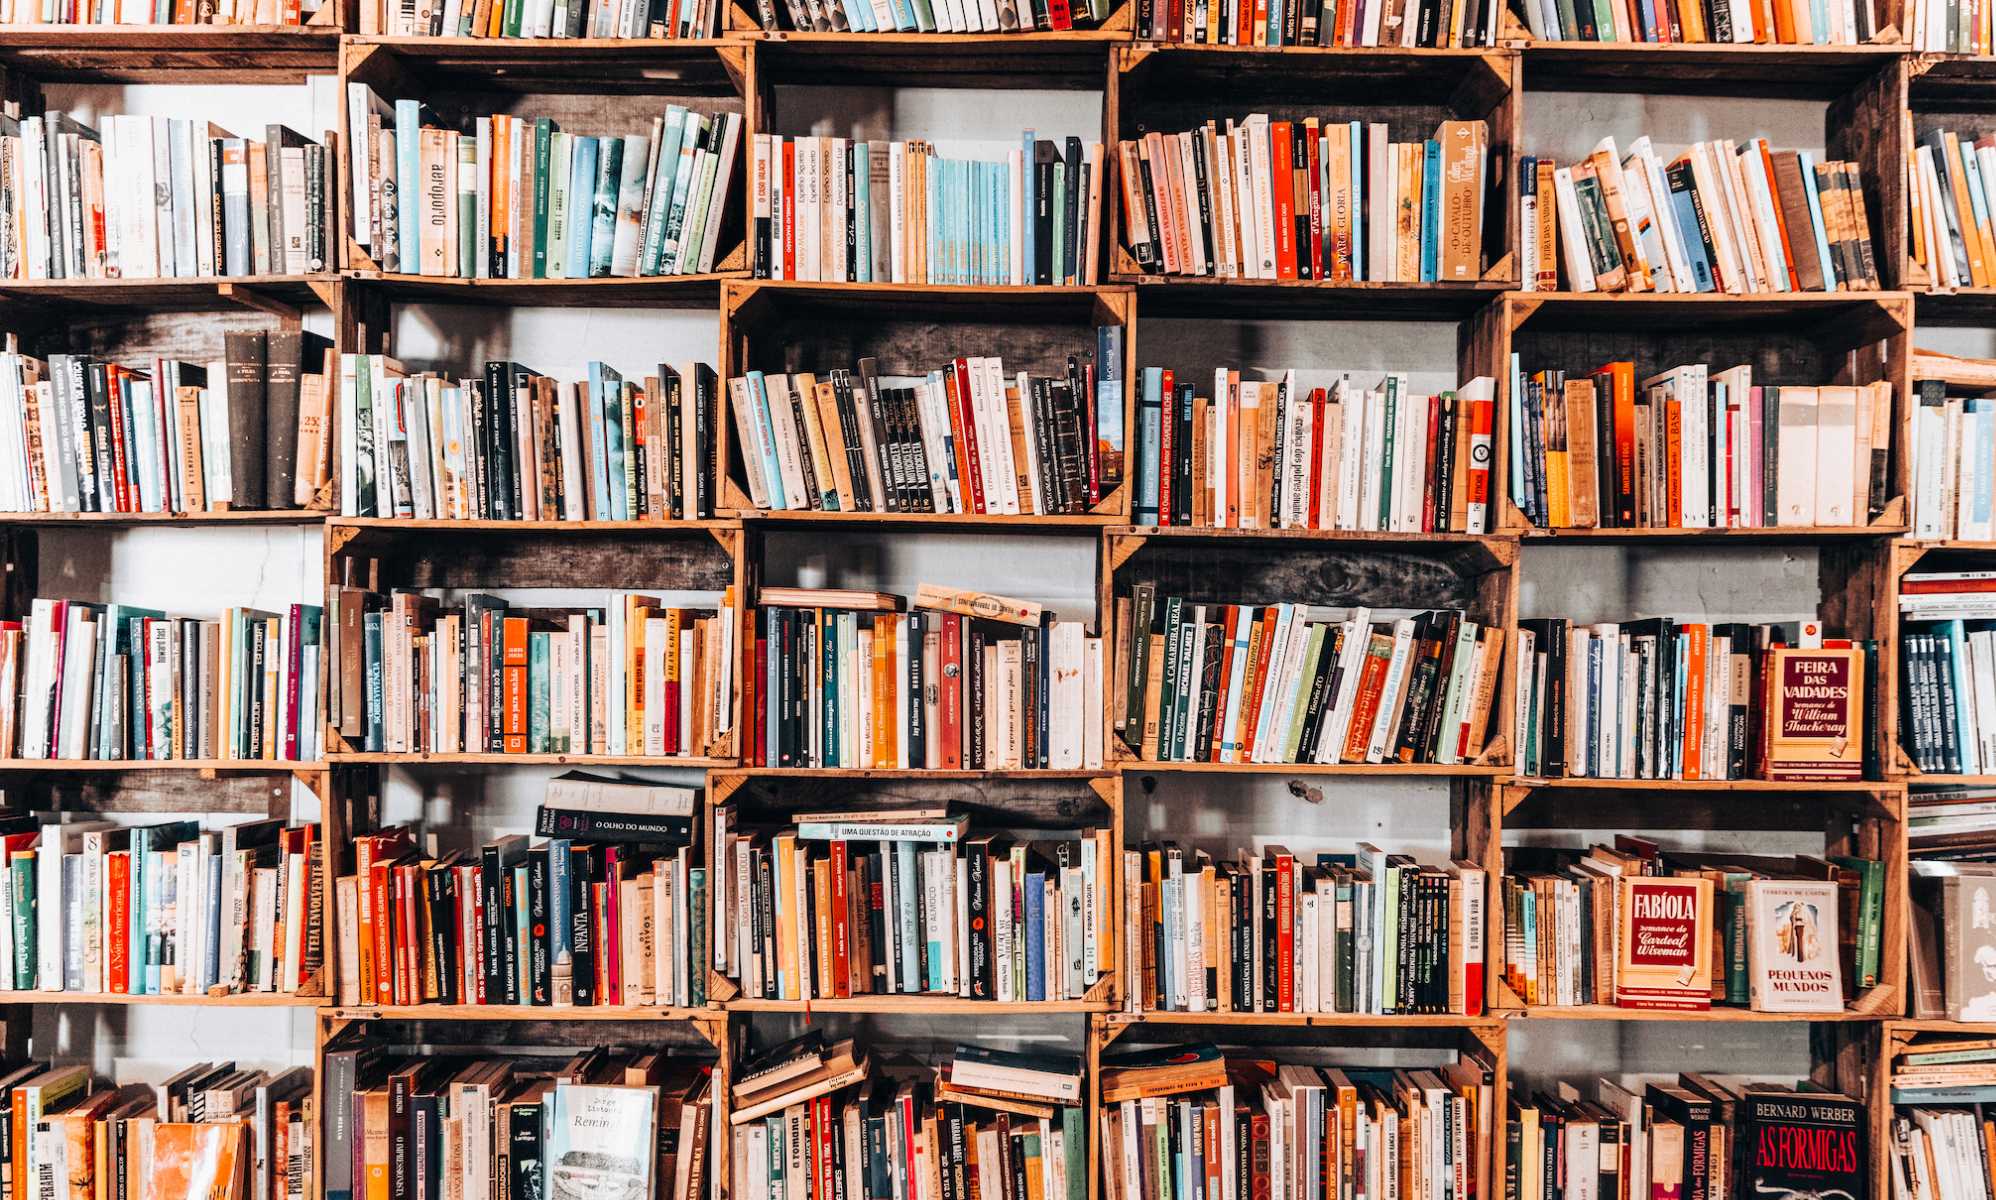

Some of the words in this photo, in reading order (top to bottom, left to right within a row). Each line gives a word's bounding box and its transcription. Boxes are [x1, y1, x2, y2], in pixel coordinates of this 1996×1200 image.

[797, 149, 806, 178] Secreto
[808, 149, 818, 178] Secreto
[427, 164, 449, 226] aeroporto
[797, 177, 808, 204] Espelho
[808, 177, 819, 204] Espelho
[1311, 190, 1321, 235] d'Artagnan
[1451, 196, 1461, 235] CAVALO
[1461, 189, 1473, 239] OUTUBRO
[1670, 408, 1678, 434] BASE
[912, 442, 925, 483] MOTOCICLETA
[1290, 464, 1304, 492] pobres
[1621, 466, 1631, 495] SEMENTES
[1172, 602, 1180, 627] REAL
[1181, 629, 1192, 667] PALMER
[1795, 660, 1838, 674] FEIRA
[1804, 674, 1827, 685] DAS
[1180, 667, 1190, 697] MICHAEL
[1783, 686, 1847, 698] VAIDADES
[1792, 708, 1838, 721] William
[1793, 701, 1820, 709] romance
[1826, 700, 1835, 709] de
[1178, 711, 1187, 736] Paciente
[1784, 720, 1847, 735] Thackeray
[596, 821, 603, 829] O
[603, 821, 624, 831] OLHO
[625, 822, 636, 832] DO
[637, 823, 668, 834] MUNDO
[842, 827, 858, 837] UMA
[858, 825, 890, 837] QUESTÃO
[890, 827, 899, 837] DE
[899, 825, 932, 839] ATRAÇÃO
[310, 863, 323, 926] ENVOLVENTE
[473, 873, 483, 908] Konsalik
[1085, 882, 1094, 909] RAQUEL
[114, 890, 124, 938] Americana
[1634, 889, 1695, 920] FABÍOLA
[574, 911, 589, 953] INFANTA
[1086, 910, 1094, 932] PRIMA
[1639, 924, 1675, 933] romance
[308, 927, 320, 953] TEIA
[476, 931, 484, 953] Grande
[639, 932, 645, 942] OS
[644, 915, 653, 958] CATIVOS
[1638, 930, 1689, 948] Cardeal
[20, 952, 32, 975] David
[113, 939, 122, 963] Noite
[1636, 945, 1688, 958] Wiseman
[113, 964, 122, 972] A
[478, 965, 487, 982] Signo
[1735, 964, 1744, 972] O
[1767, 970, 1833, 981] PEQUENOS
[478, 986, 486, 999] Sob
[1772, 982, 1830, 993] MUNDOS
[1756, 1103, 1807, 1119] BERNARD
[1811, 1106, 1856, 1122] WERBER
[790, 1116, 800, 1161] romana
[951, 1119, 962, 1145] BARBARA
[1694, 1130, 1706, 1177] FORMIGAS
[1757, 1126, 1777, 1168] AS
[1780, 1127, 1856, 1173] FORMIGAS
[287, 1154, 303, 1195] PERAHIM
[395, 1143, 404, 1197] IMPRESSIONISTA
[791, 1160, 800, 1169] a
